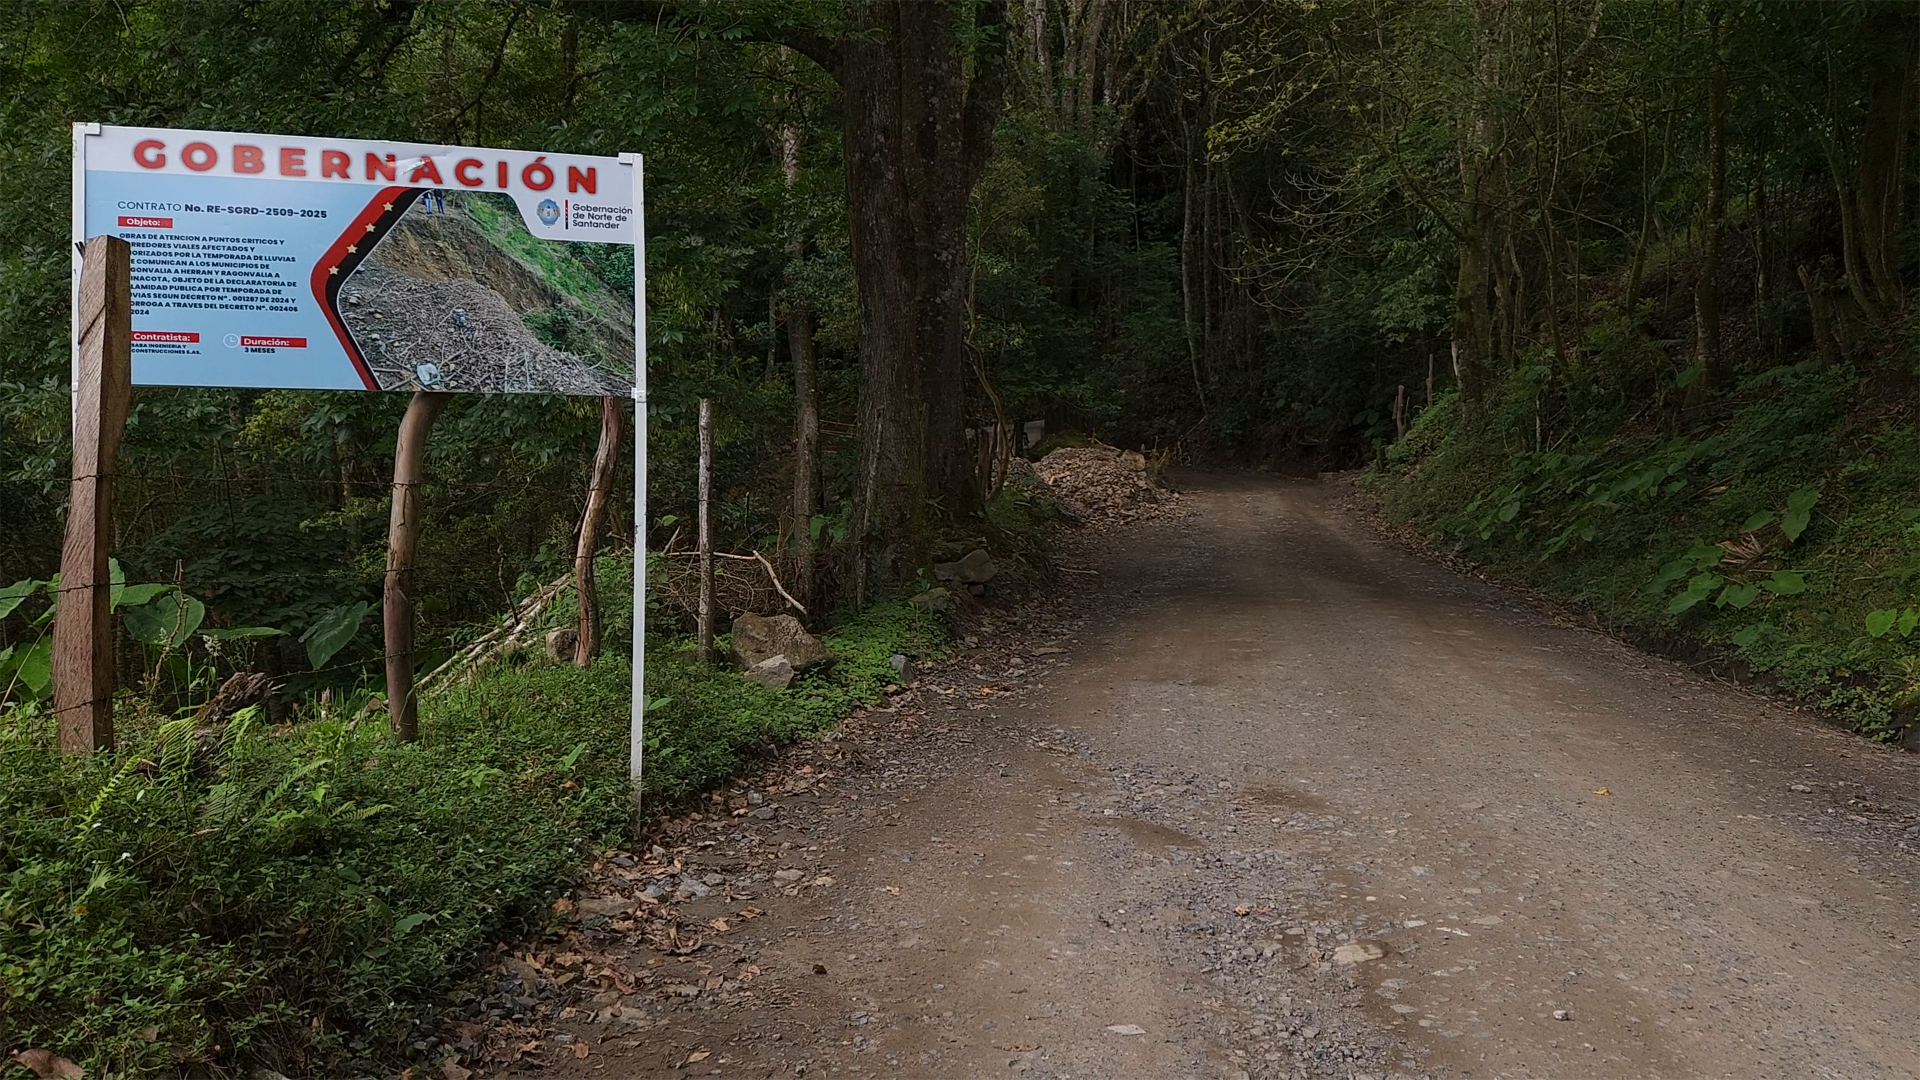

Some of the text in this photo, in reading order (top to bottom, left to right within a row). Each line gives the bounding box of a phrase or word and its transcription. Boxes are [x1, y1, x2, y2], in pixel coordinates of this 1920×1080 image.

[134, 140, 596, 194] GOBERNACIÓN
[118, 201, 327, 218] CONTRATO No. RE-SGRD-2509-2025
[573, 204, 632, 214] Gobernación
[126, 218, 160, 226] Objeto:
[573, 220, 619, 229] Santander
[134, 333, 190, 341] Contratista:
[244, 338, 290, 346] Duración:
